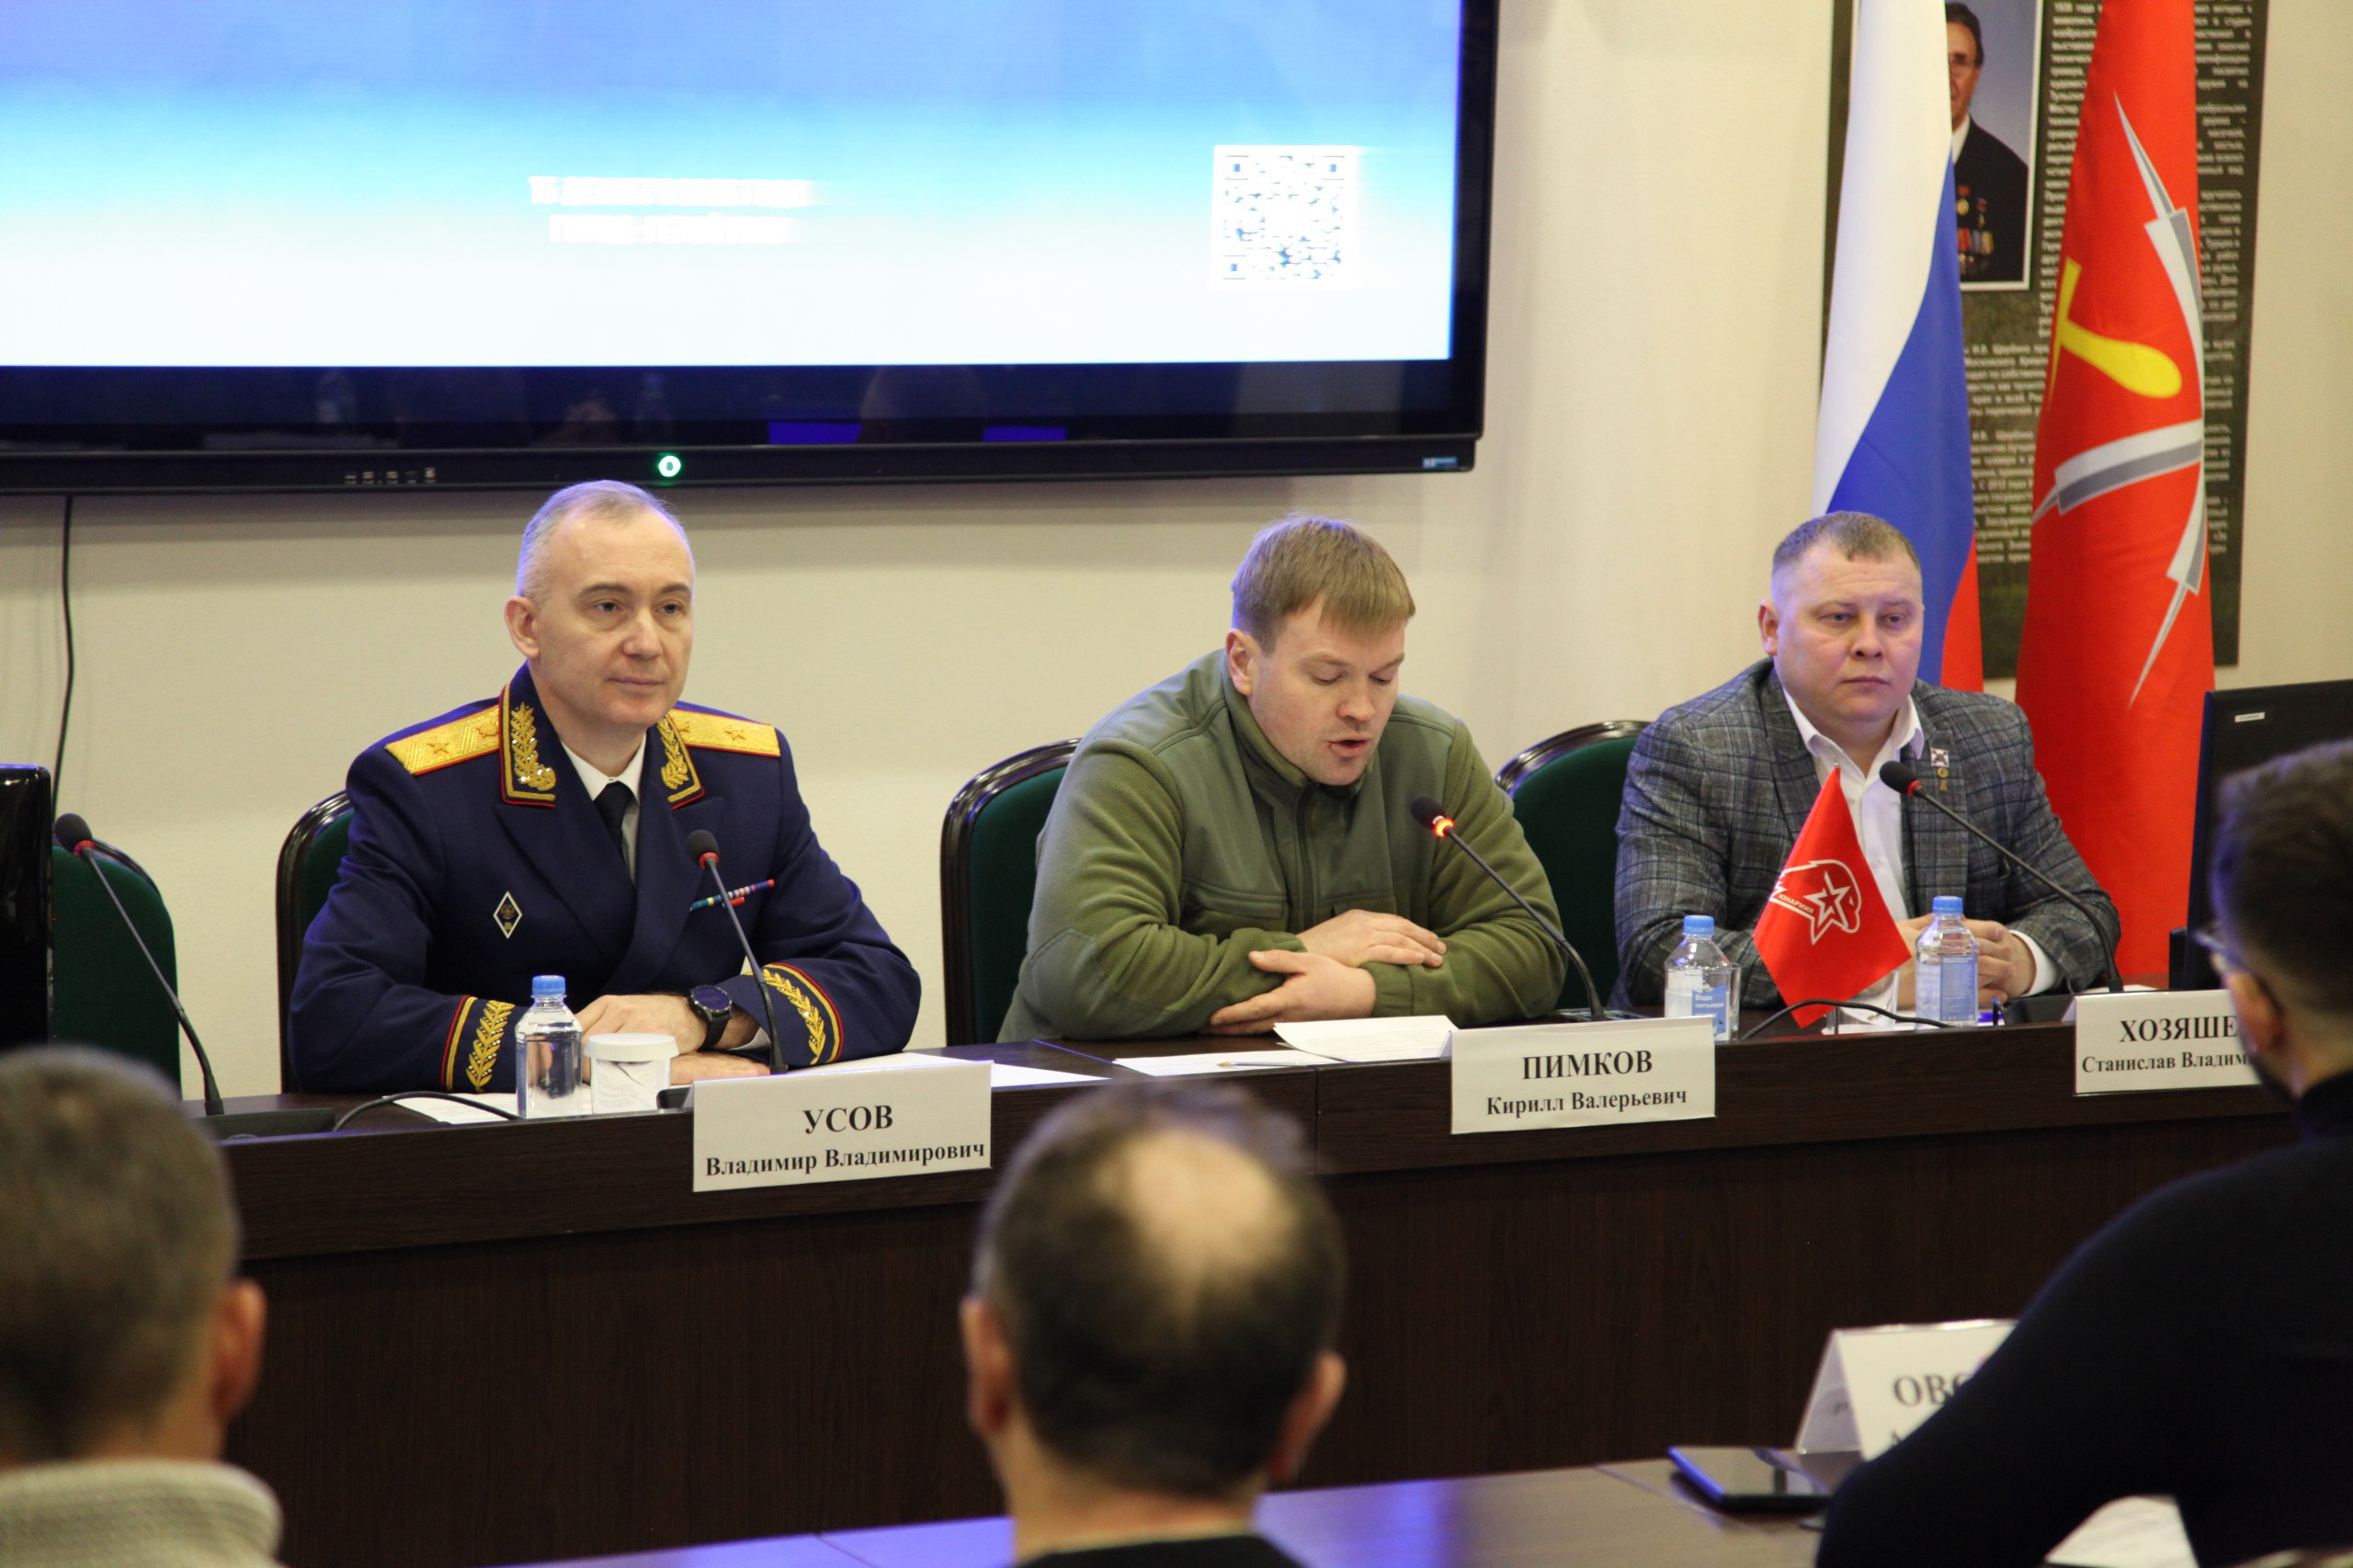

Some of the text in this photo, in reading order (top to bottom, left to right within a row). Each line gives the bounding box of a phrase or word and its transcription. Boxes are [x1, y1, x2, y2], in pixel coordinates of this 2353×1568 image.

[1778, 893, 1814, 915] ЮНАРМИЯ
[2120, 1016, 2238, 1042] ХОЗЯШЕ
[1522, 1050, 1653, 1080] ПИМКОВ
[2082, 1051, 2247, 1073] Станислав Владим
[1486, 1090, 1687, 1119] Кирилл Валерьевич
[801, 1105, 893, 1134] УСОВ
[706, 1143, 985, 1176] Владимир Владимирович
